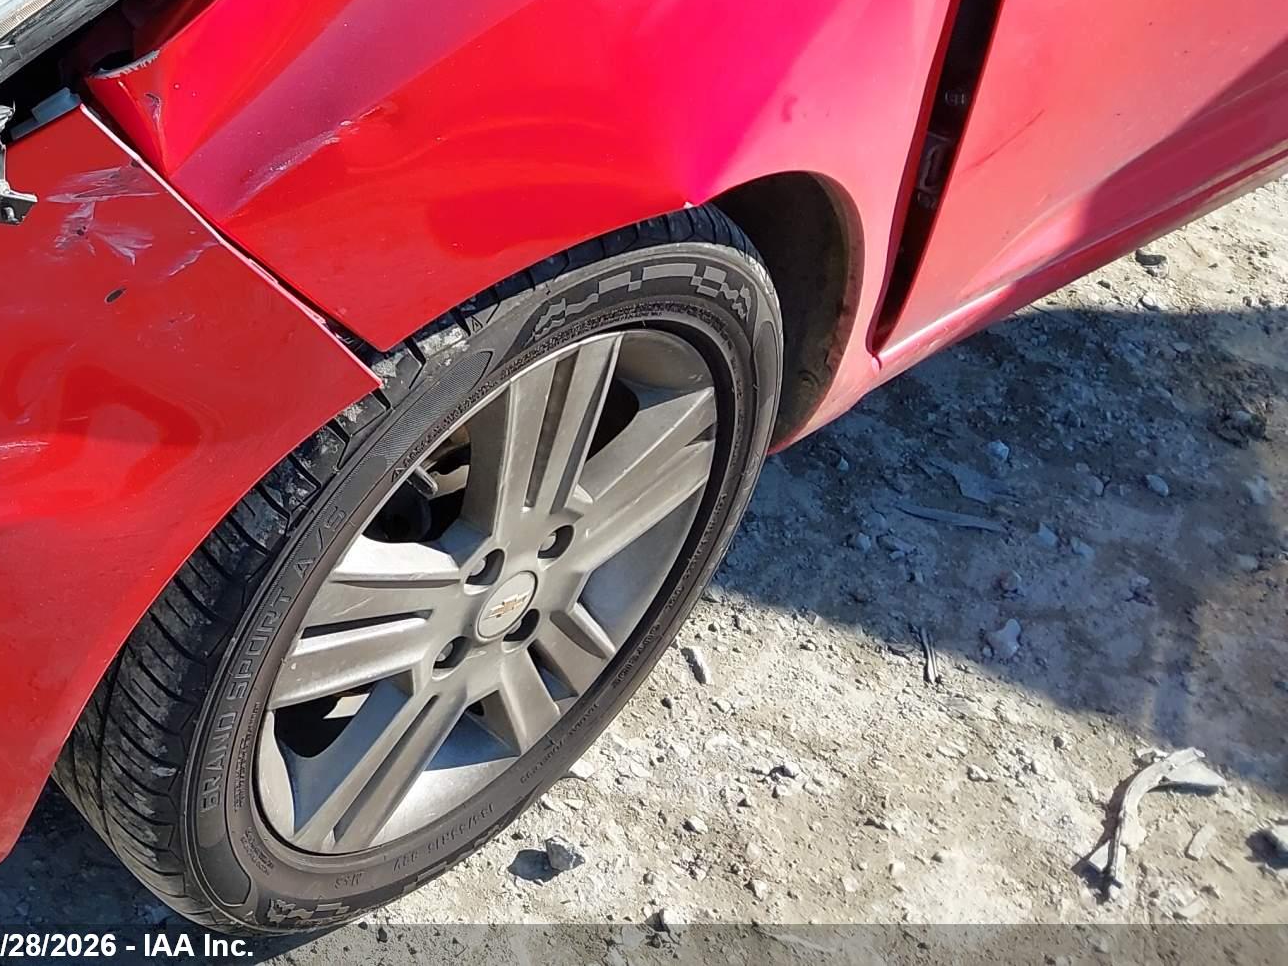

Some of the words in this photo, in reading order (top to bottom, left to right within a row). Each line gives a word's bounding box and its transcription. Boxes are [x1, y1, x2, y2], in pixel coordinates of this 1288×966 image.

[199, 711, 237, 813] GRAND
[227, 587, 291, 701] SPORT
[292, 506, 345, 579] A/S
